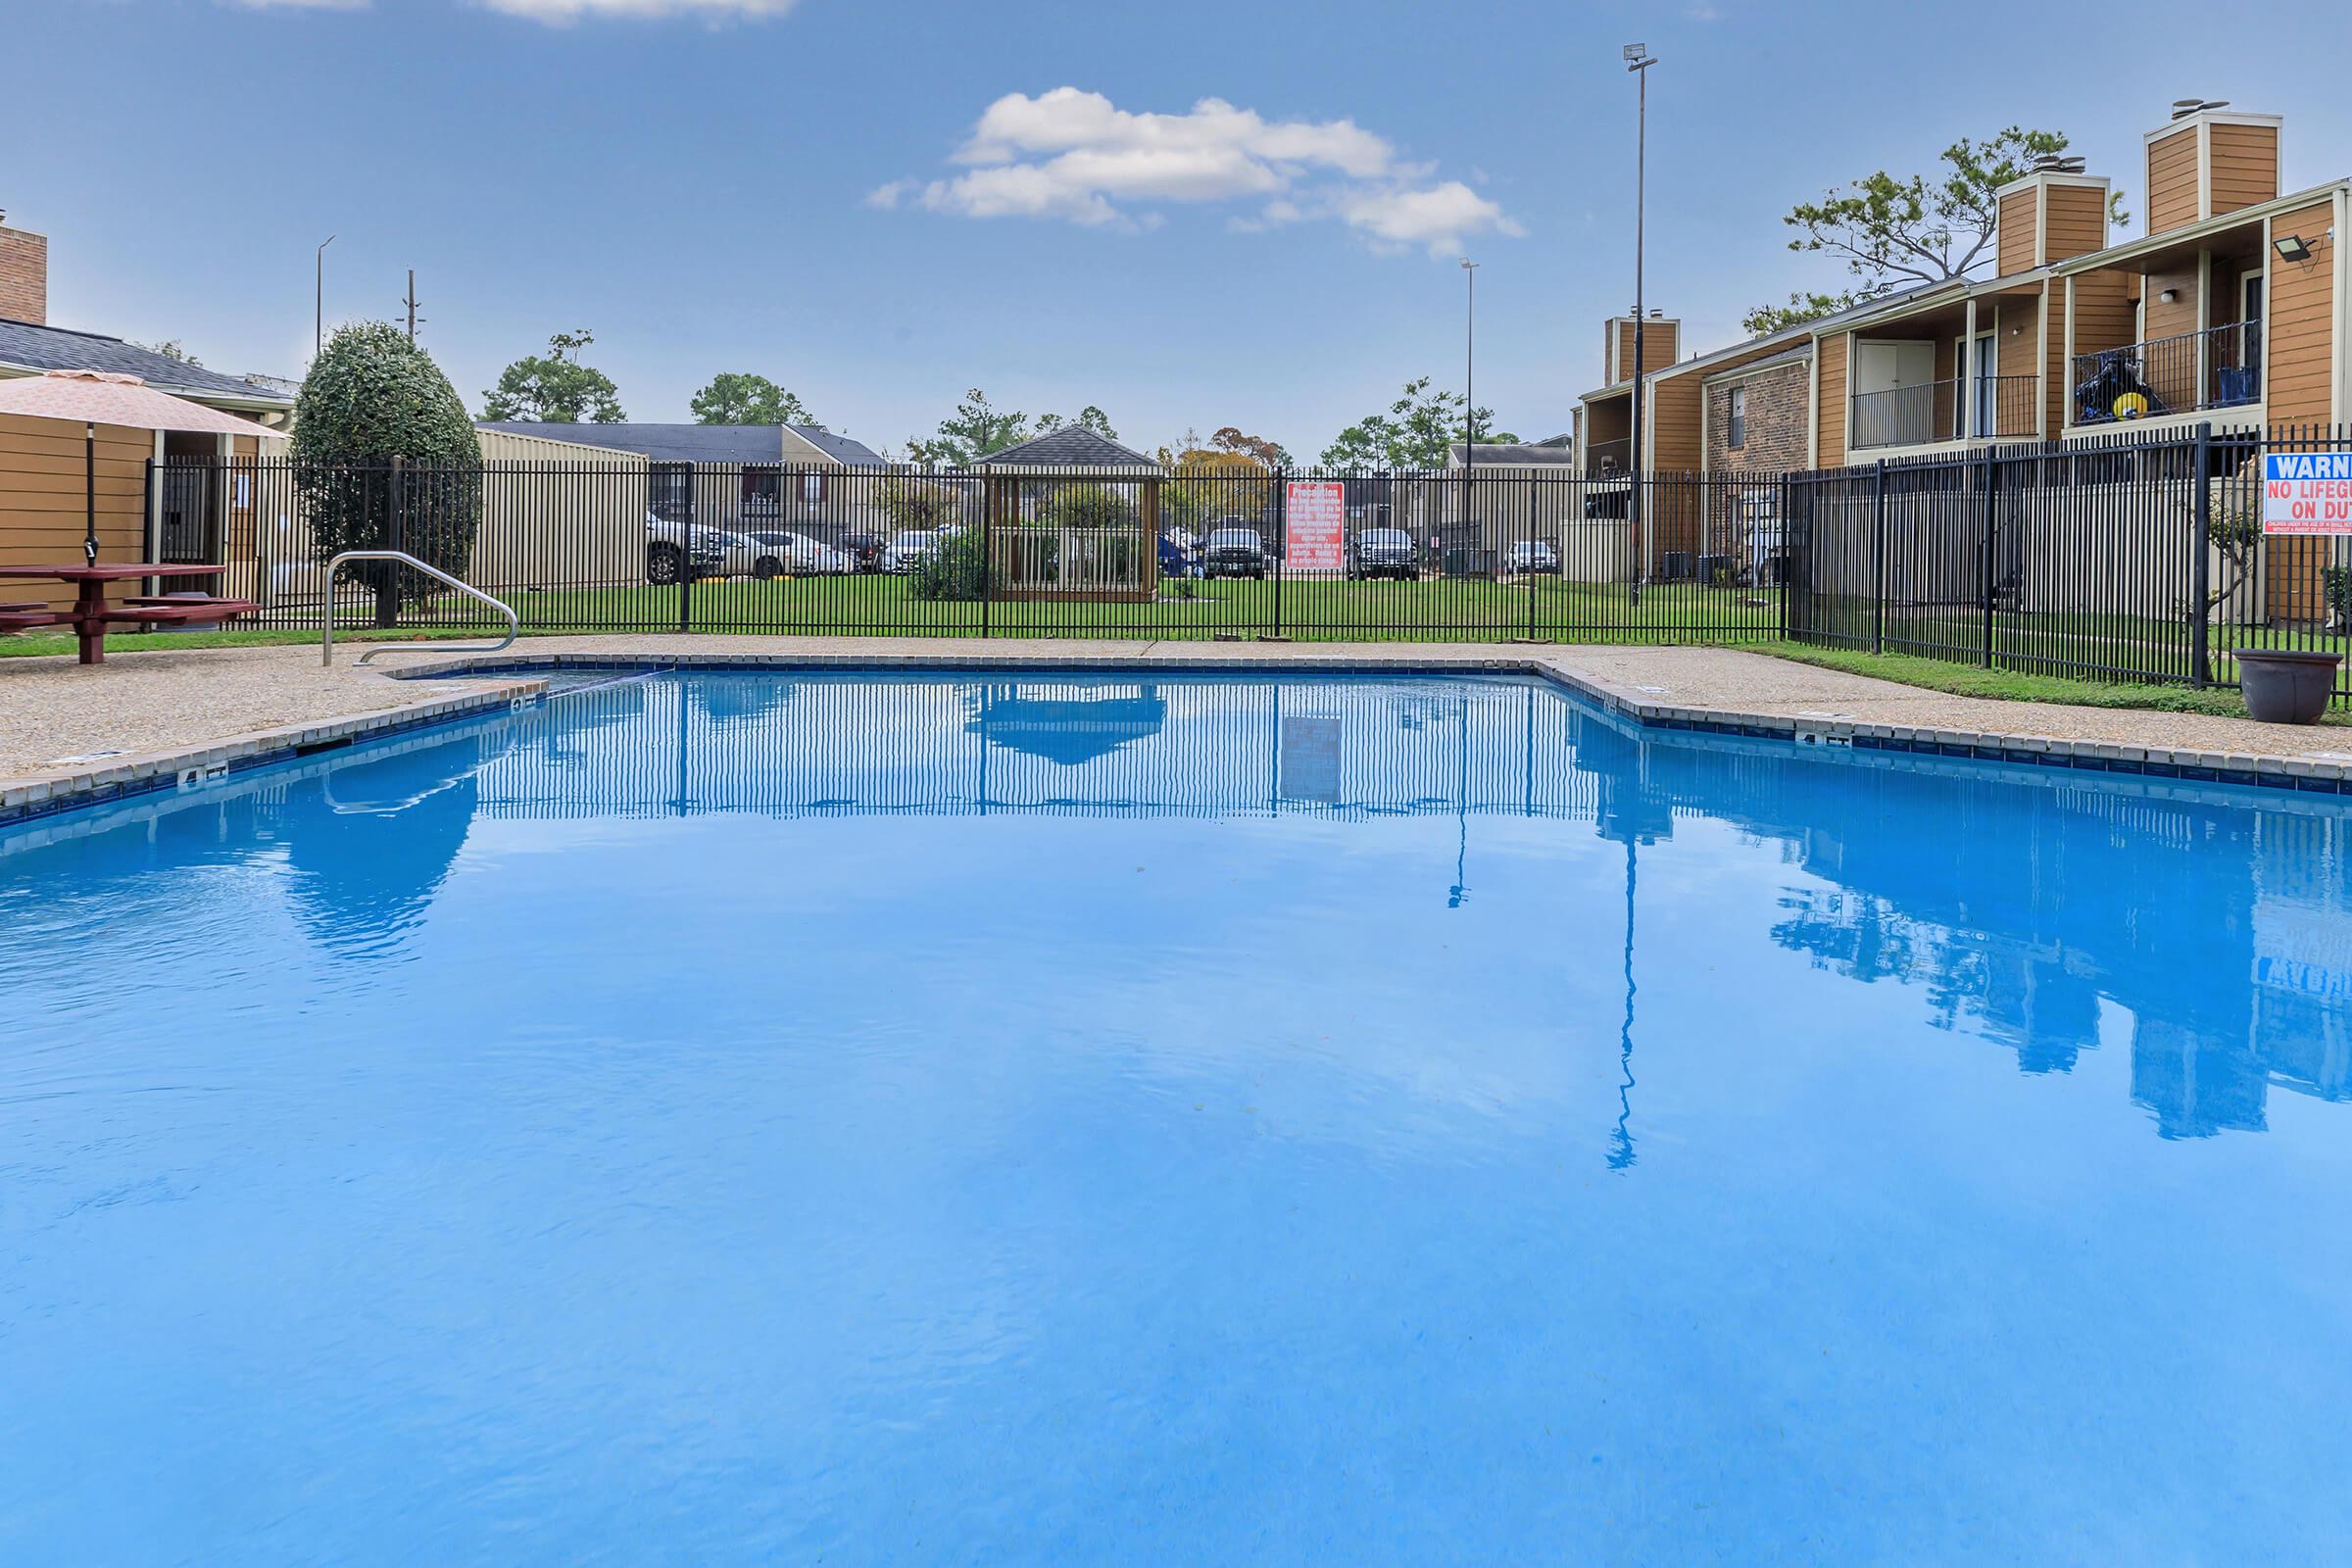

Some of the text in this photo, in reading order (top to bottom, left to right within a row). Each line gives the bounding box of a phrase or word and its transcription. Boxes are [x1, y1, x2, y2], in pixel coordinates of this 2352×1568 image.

[2277, 456, 2352, 479] WARN
[2268, 481, 2291, 499] NO
[2291, 501, 2316, 519] ON
